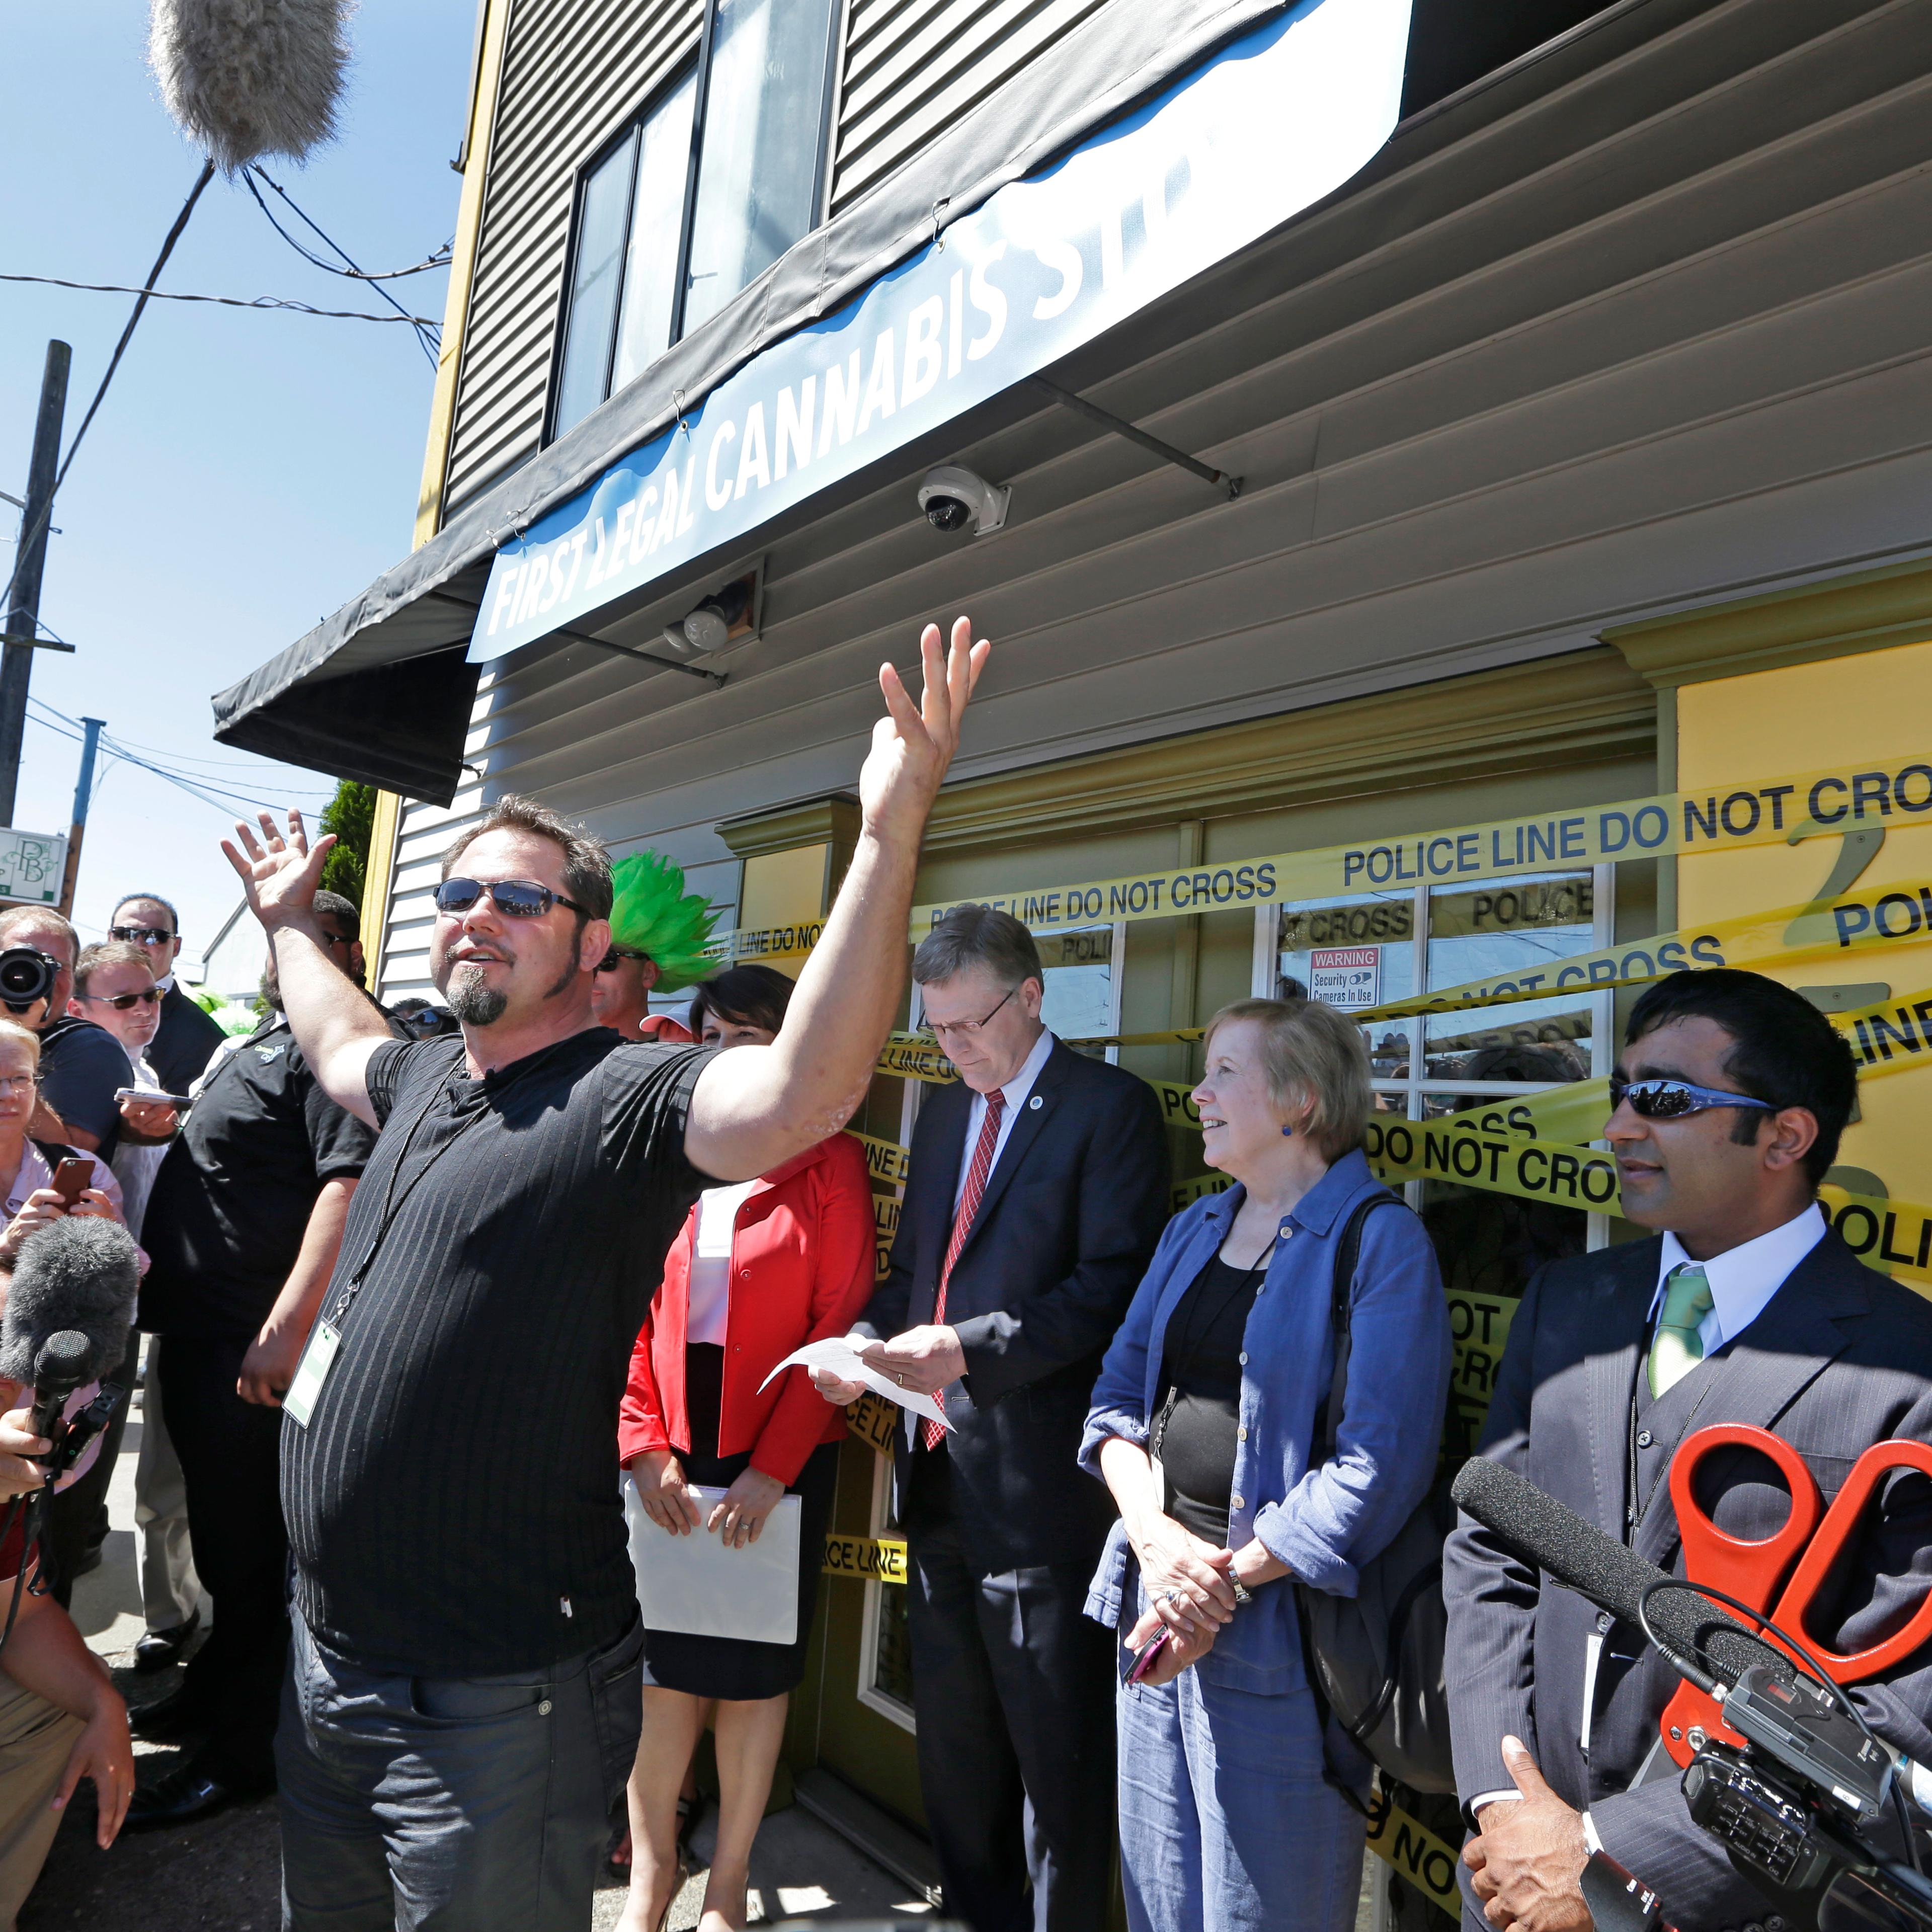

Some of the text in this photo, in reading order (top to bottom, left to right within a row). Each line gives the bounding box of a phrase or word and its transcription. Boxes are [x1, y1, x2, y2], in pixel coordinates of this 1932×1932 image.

[486, 528, 589, 636] FIRST
[584, 455, 697, 591] LEGAL
[704, 238, 1007, 512] CANNABIS
[1067, 888, 1103, 920] DO
[1109, 879, 1165, 916] NOT
[1171, 863, 1276, 907] CROSS
[1344, 833, 1480, 887] POLICE
[1492, 817, 1586, 868] LINE
[1599, 805, 1669, 853] DO
[1683, 785, 1795, 842] NOT
[738, 930, 770, 955] LINE
[772, 929, 794, 952] DO
[1315, 951, 1375, 967] WARNING
[1314, 973, 1347, 988] Security
[1314, 989, 1372, 1003] Cameras In Use
[1424, 1132, 1509, 1182] NOT
[1517, 1148, 1622, 1204] CRO
[1447, 1299, 1501, 1345] OT
[857, 1544, 901, 1576] LINE
[1392, 1821, 1456, 1895] NO
